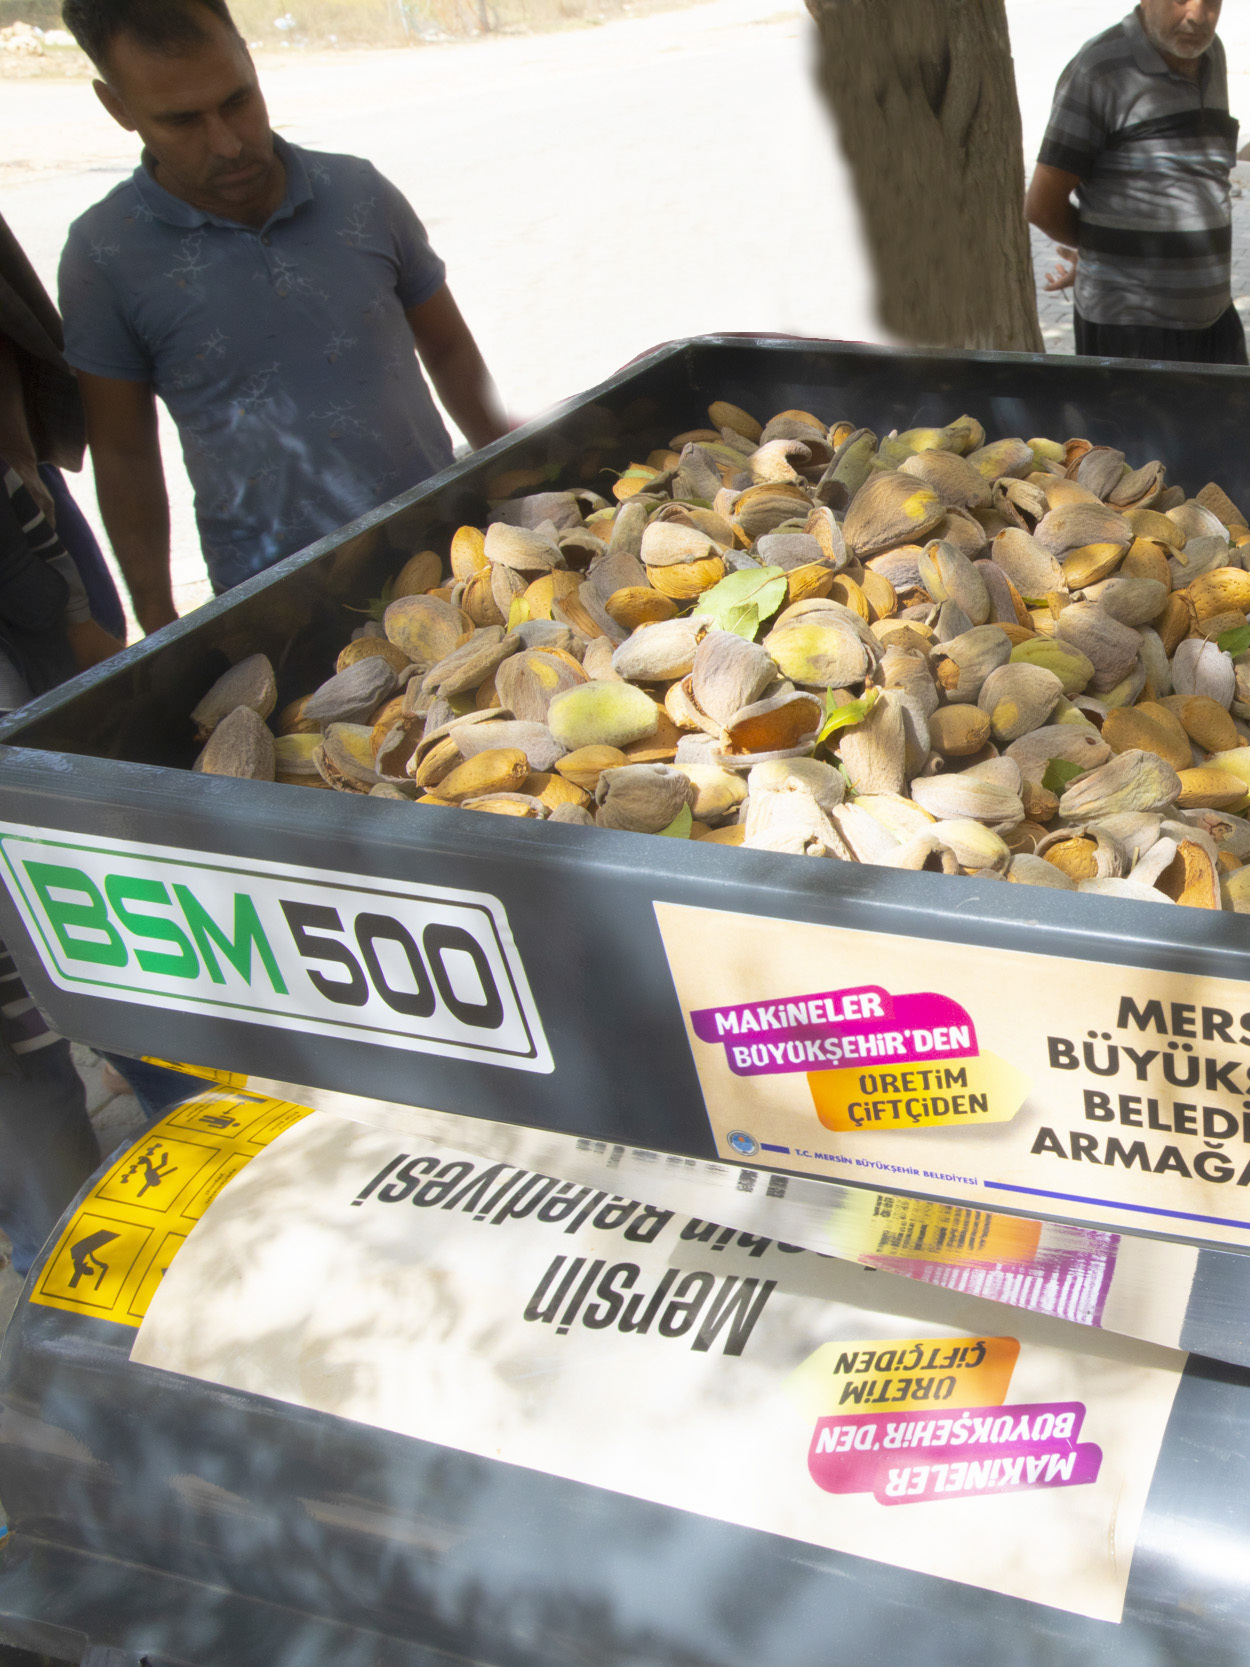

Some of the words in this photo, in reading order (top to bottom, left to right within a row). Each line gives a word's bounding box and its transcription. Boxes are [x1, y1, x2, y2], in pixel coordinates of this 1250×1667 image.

[22, 859, 287, 994] BSM
[279, 899, 502, 1028] 500
[714, 992, 883, 1034] MAKİNELER
[794, 1148, 812, 1159] T.C.
[814, 1152, 853, 1167] MERSİN
[855, 1158, 920, 1177] BÜYÜKŞEHİR
[923, 1169, 979, 1186] BELEDİYESİ
[523, 1254, 776, 1354] Mersin
